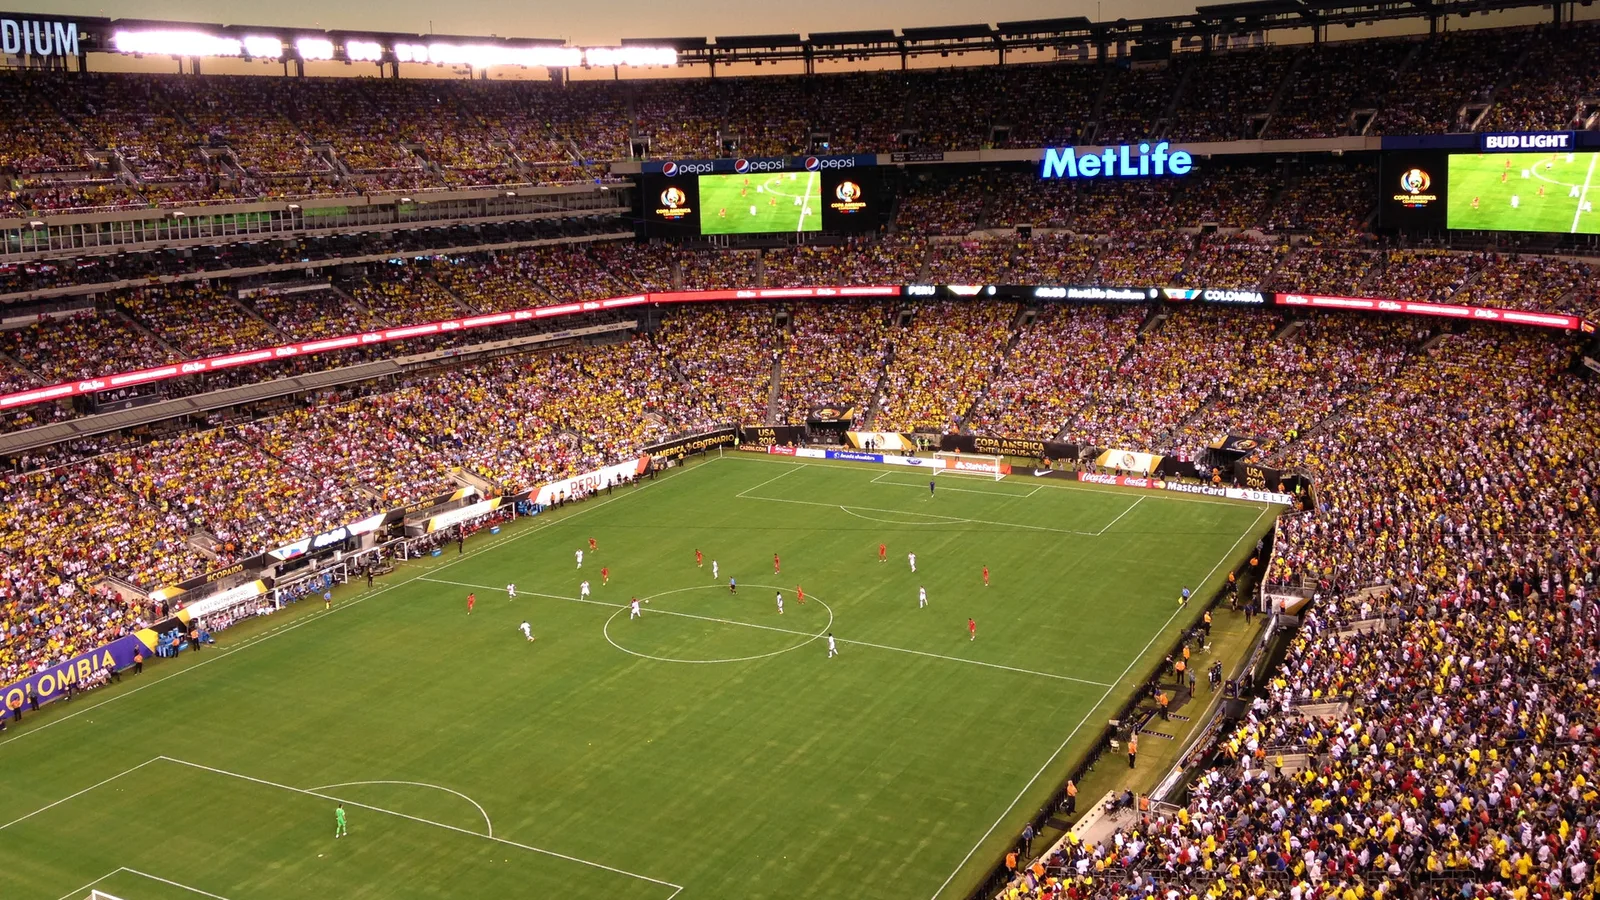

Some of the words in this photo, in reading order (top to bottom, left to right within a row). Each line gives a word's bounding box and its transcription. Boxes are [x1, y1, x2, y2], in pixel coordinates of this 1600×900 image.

[1, 19, 79, 56] DIUM
[1486, 135, 1519, 148] BUD
[1521, 134, 1568, 148] LIGHT
[750, 158, 785, 173] pepsi
[820, 157, 855, 170] pepsi
[1042, 142, 1192, 178] MetLife
[680, 162, 714, 175] pepsi
[908, 285, 936, 295] PERU
[1204, 290, 1264, 303] COLOMBIA
[758, 429, 775, 437] USA
[692, 434, 735, 450] CENTENARIO
[759, 437, 776, 446] 2016
[975, 437, 1000, 448] COPA
[1002, 439, 1045, 451] AMERICA
[1246, 466, 1264, 478] USA
[570, 474, 602, 496] PERU
[1167, 482, 1225, 496] MasterCard
[1253, 492, 1292, 504] DELTA
[207, 564, 243, 582] #COPA100
[0, 649, 117, 717] OLOMBIA
